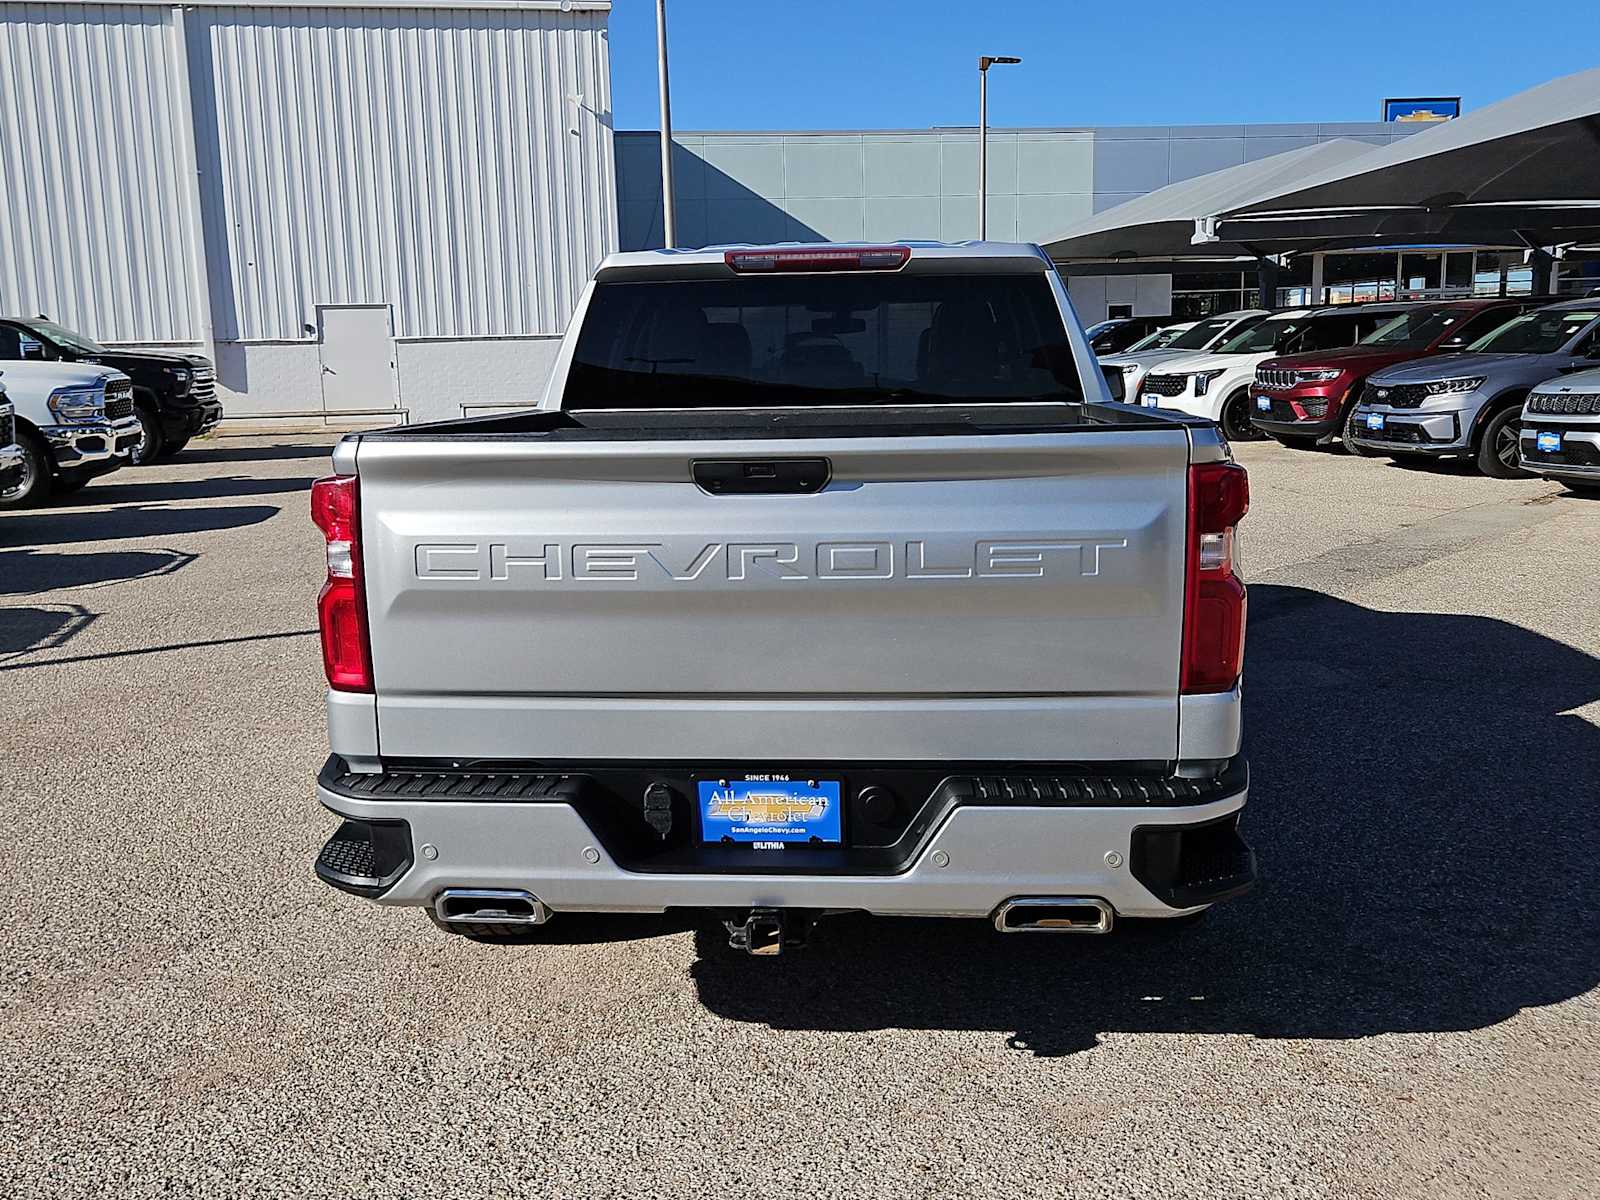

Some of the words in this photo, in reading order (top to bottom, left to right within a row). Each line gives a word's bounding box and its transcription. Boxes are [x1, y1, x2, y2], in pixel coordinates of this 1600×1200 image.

[414, 538, 1128, 581] CHEVROLET
[771, 774, 790, 782] 1946
[708, 790, 735, 805] All
[743, 792, 830, 806] American
[727, 807, 808, 823] Chevrolet
[731, 826, 806, 834] SanAngeloChevy.com
[760, 842, 785, 850] LITHIA
